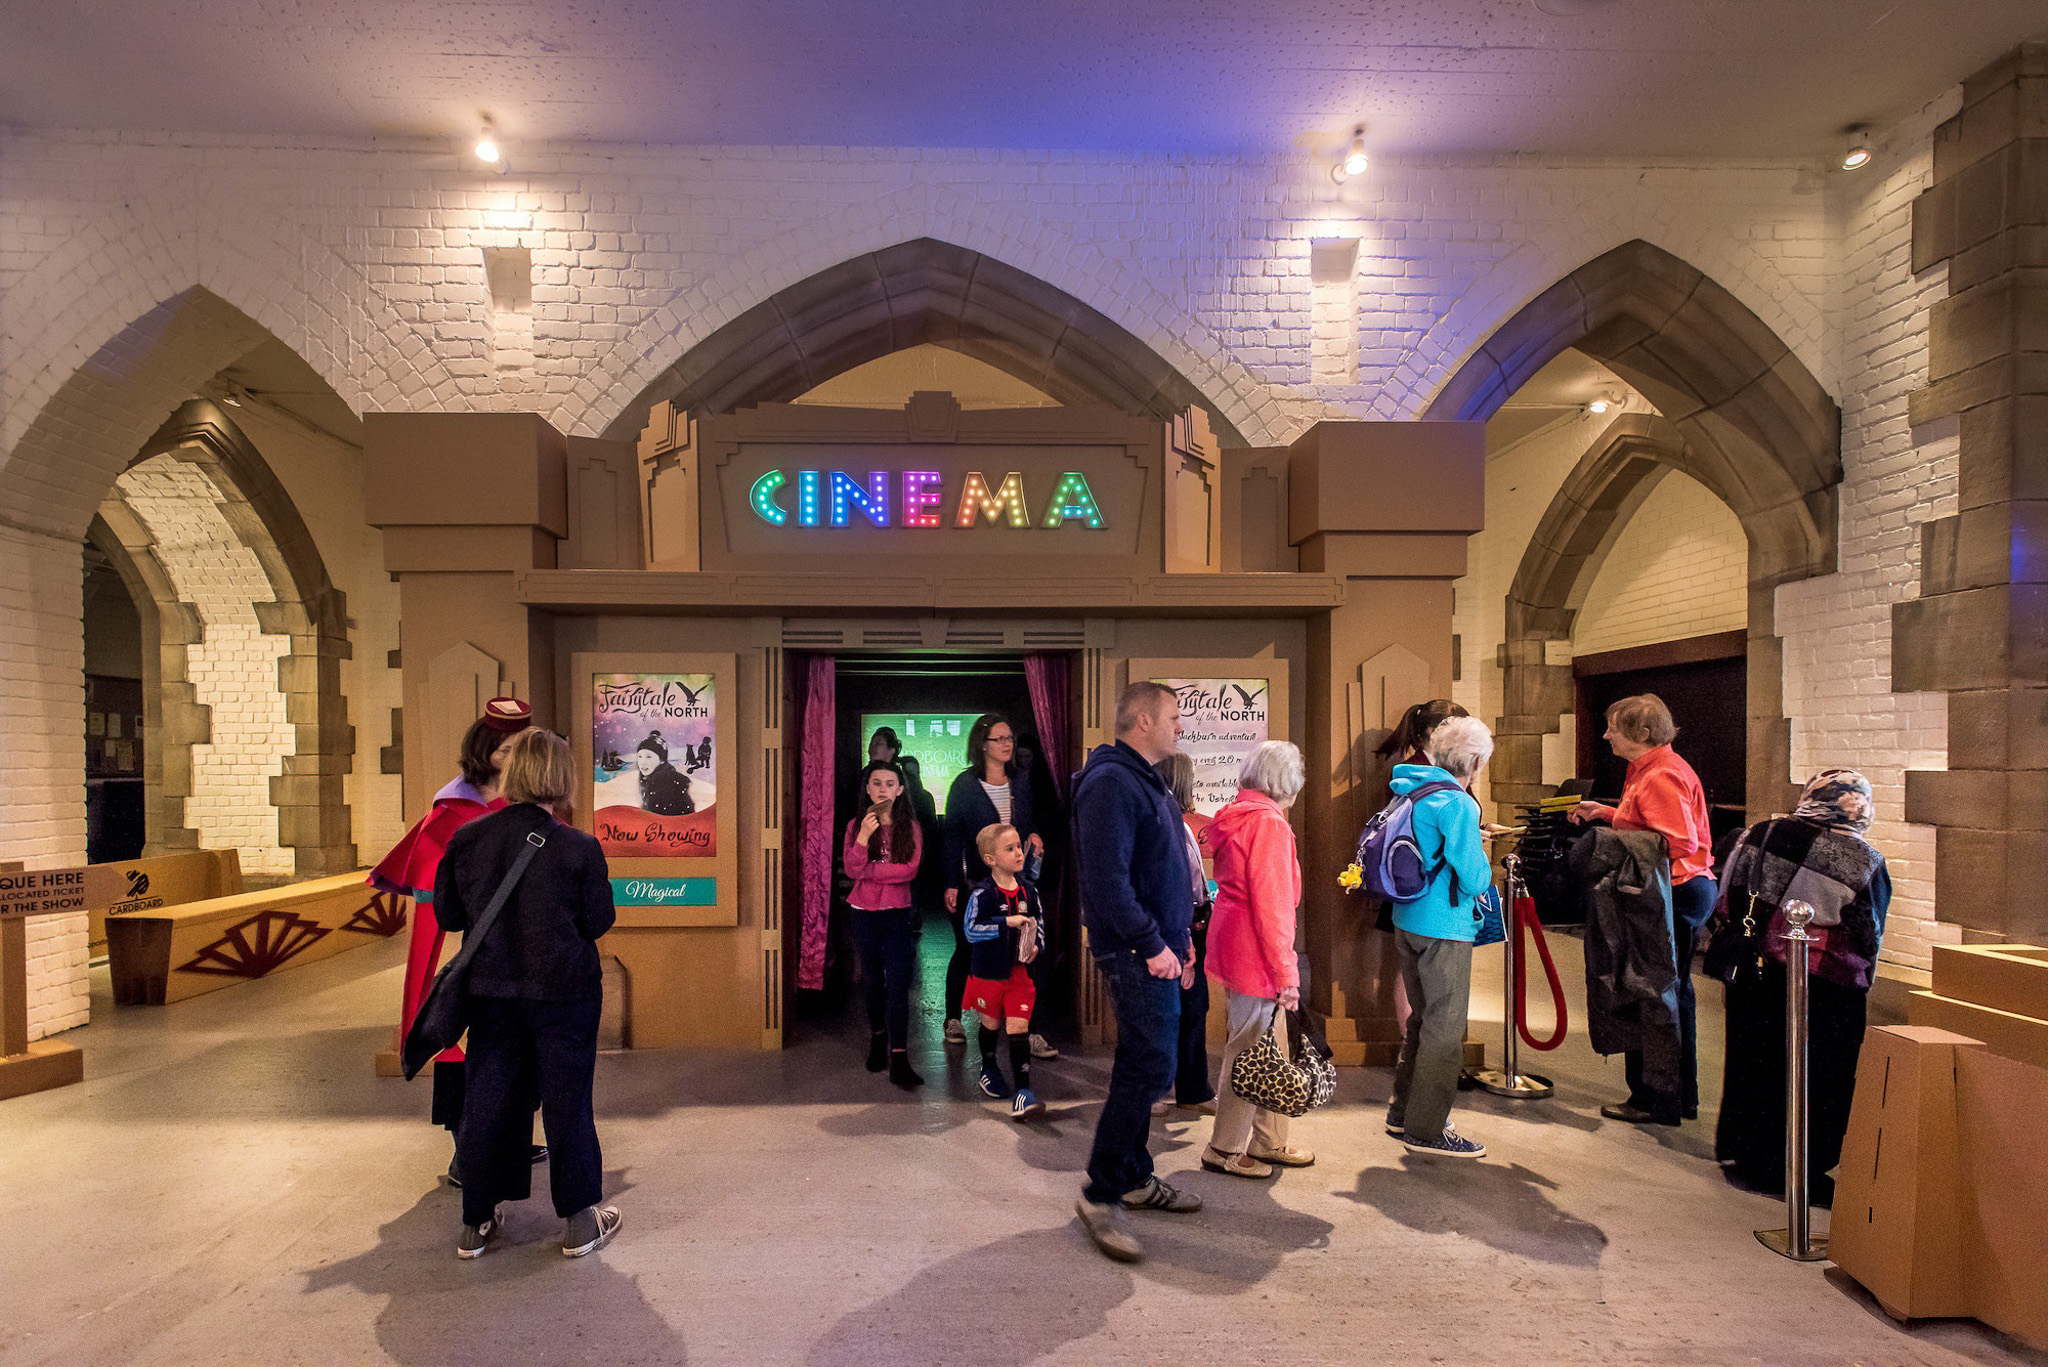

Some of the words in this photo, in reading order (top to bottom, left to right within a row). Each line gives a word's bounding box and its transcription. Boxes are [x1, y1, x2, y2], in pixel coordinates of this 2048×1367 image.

[749, 469, 1109, 530] CINEMA
[598, 682, 676, 713] Fairytale
[640, 709, 649, 721] of
[650, 708, 661, 718] the
[664, 707, 708, 718] NORTH
[1195, 712, 1205, 725] of
[1206, 712, 1218, 721] the
[1221, 711, 1265, 721] NORTH
[1218, 755, 1235, 765] 20
[600, 823, 639, 842] Now
[645, 822, 711, 848] Showing
[0, 876, 36, 889] QUE
[42, 872, 84, 886] HERE
[53, 887, 84, 896] TICKET
[625, 880, 687, 903] Magical
[13, 901, 38, 912] THE
[42, 898, 84, 909] SHOW
[108, 898, 164, 916] CARDBOARD
